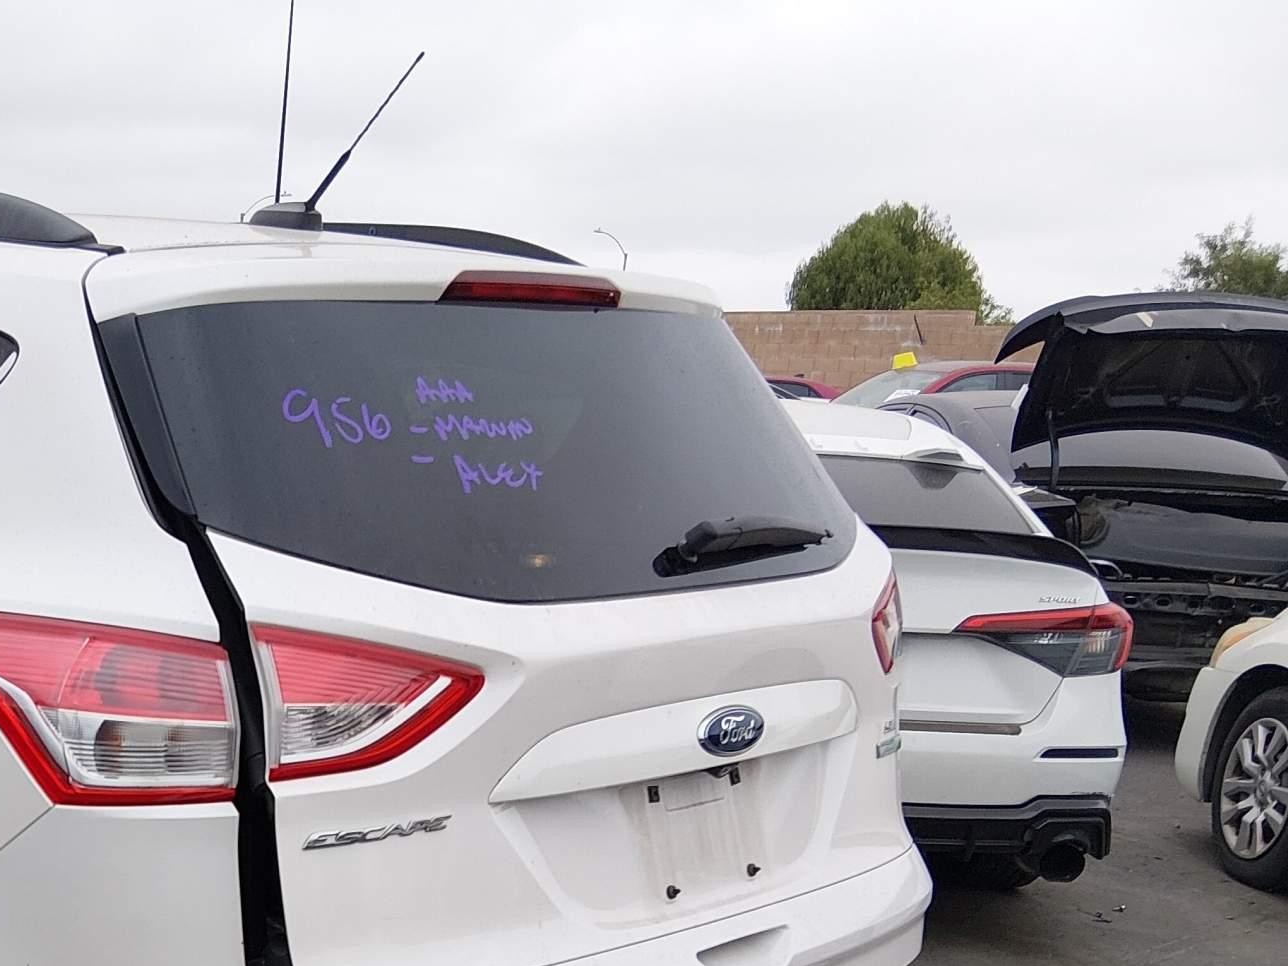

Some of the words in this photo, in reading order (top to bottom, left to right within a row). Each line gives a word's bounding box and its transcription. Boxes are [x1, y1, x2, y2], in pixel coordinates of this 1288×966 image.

[281, 387, 392, 448] 956
[720, 714, 756, 745] Ford
[302, 814, 453, 851] ESCAPE
